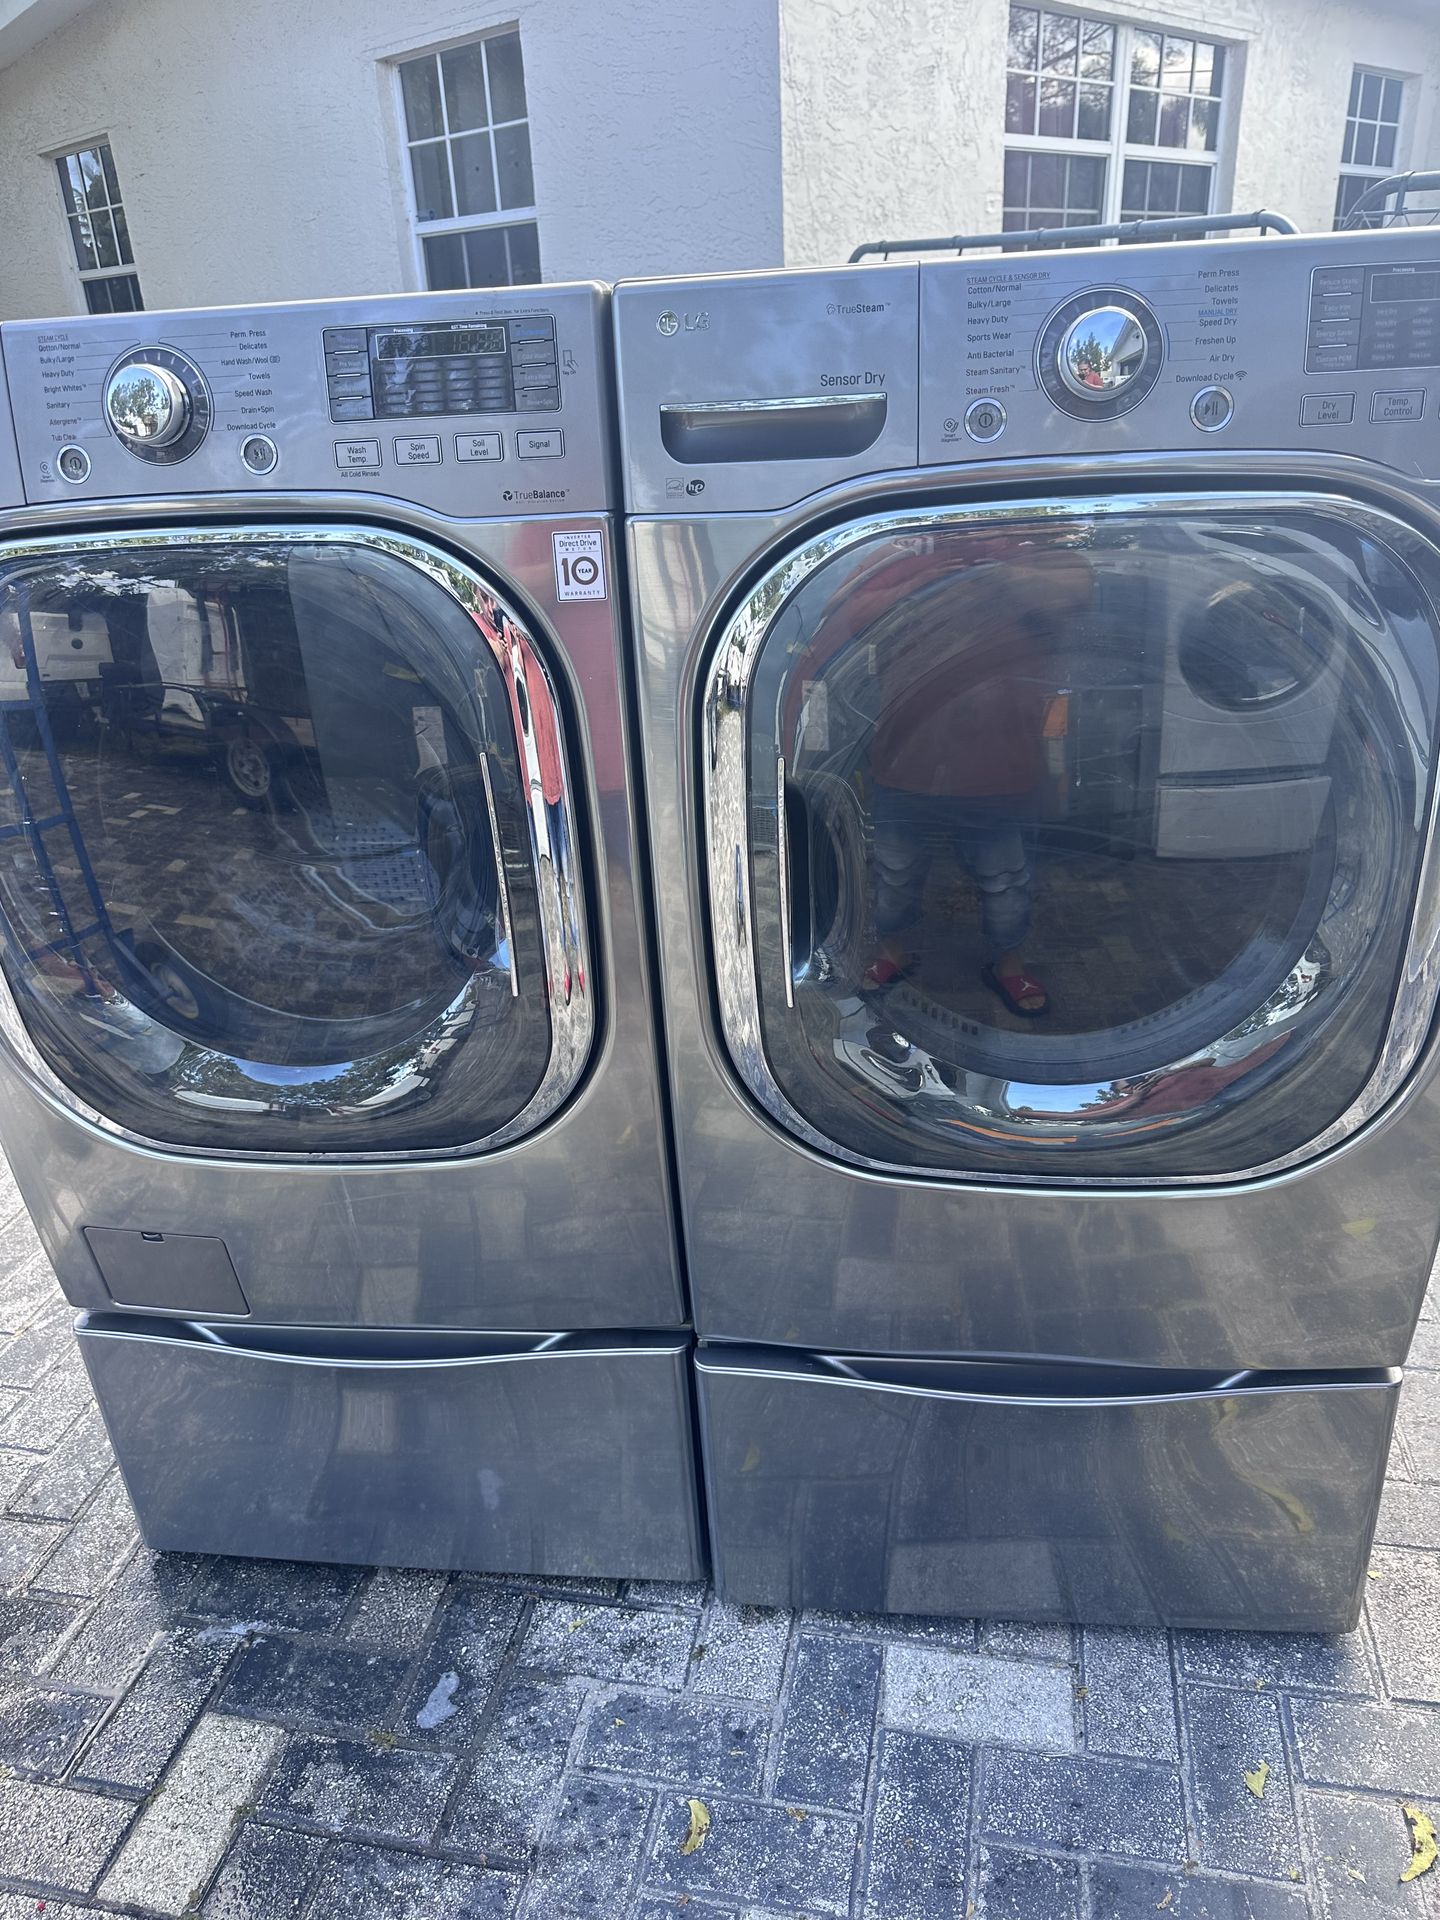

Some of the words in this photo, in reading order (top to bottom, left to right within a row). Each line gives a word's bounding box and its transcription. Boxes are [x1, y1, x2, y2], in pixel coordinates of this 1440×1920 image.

[1198, 270, 1217, 278] Perm
[1219, 269, 1240, 277] Press
[967, 276, 988, 284] STEAM
[968, 283, 1022, 295] Cotton/Normal
[1205, 284, 1239, 293] Delicates
[968, 300, 1011, 309] Bulky/Large
[1212, 297, 1238, 305] Towels
[684, 312, 711, 331] LG
[968, 317, 989, 325] Heavy
[992, 316, 1008, 324] Duty
[1200, 318, 1222, 327] Speed
[1224, 318, 1237, 326] Dry
[967, 334, 991, 343] Sports
[1195, 337, 1224, 345] Freshen
[1226, 336, 1236, 344] Up
[968, 352, 981, 360] Anti
[983, 349, 1014, 359] Bacterial
[1210, 354, 1221, 362] Air
[1222, 354, 1235, 362] Dry
[61, 370, 74, 378] Duty
[248, 372, 270, 380] Towels
[966, 368, 988, 377] Steam
[820, 373, 862, 387] Sensor
[865, 372, 886, 386] Dry
[1176, 374, 1212, 383] Download
[1214, 372, 1234, 382] Cycle
[44, 386, 61, 394] Bright
[234, 390, 253, 398] Speed
[966, 387, 988, 395] Steam
[1322, 401, 1336, 410] Dry
[1318, 410, 1339, 419] Level
[1384, 407, 1413, 416] Control
[227, 423, 258, 431] Download
[410, 443, 425, 452] Spin
[472, 439, 485, 447] Soil
[528, 440, 550, 450] Signal
[347, 446, 366, 454] Wash
[471, 448, 488, 456] Level
[408, 452, 429, 461] Speed
[687, 480, 704, 496] he
[561, 556, 599, 586] 10
